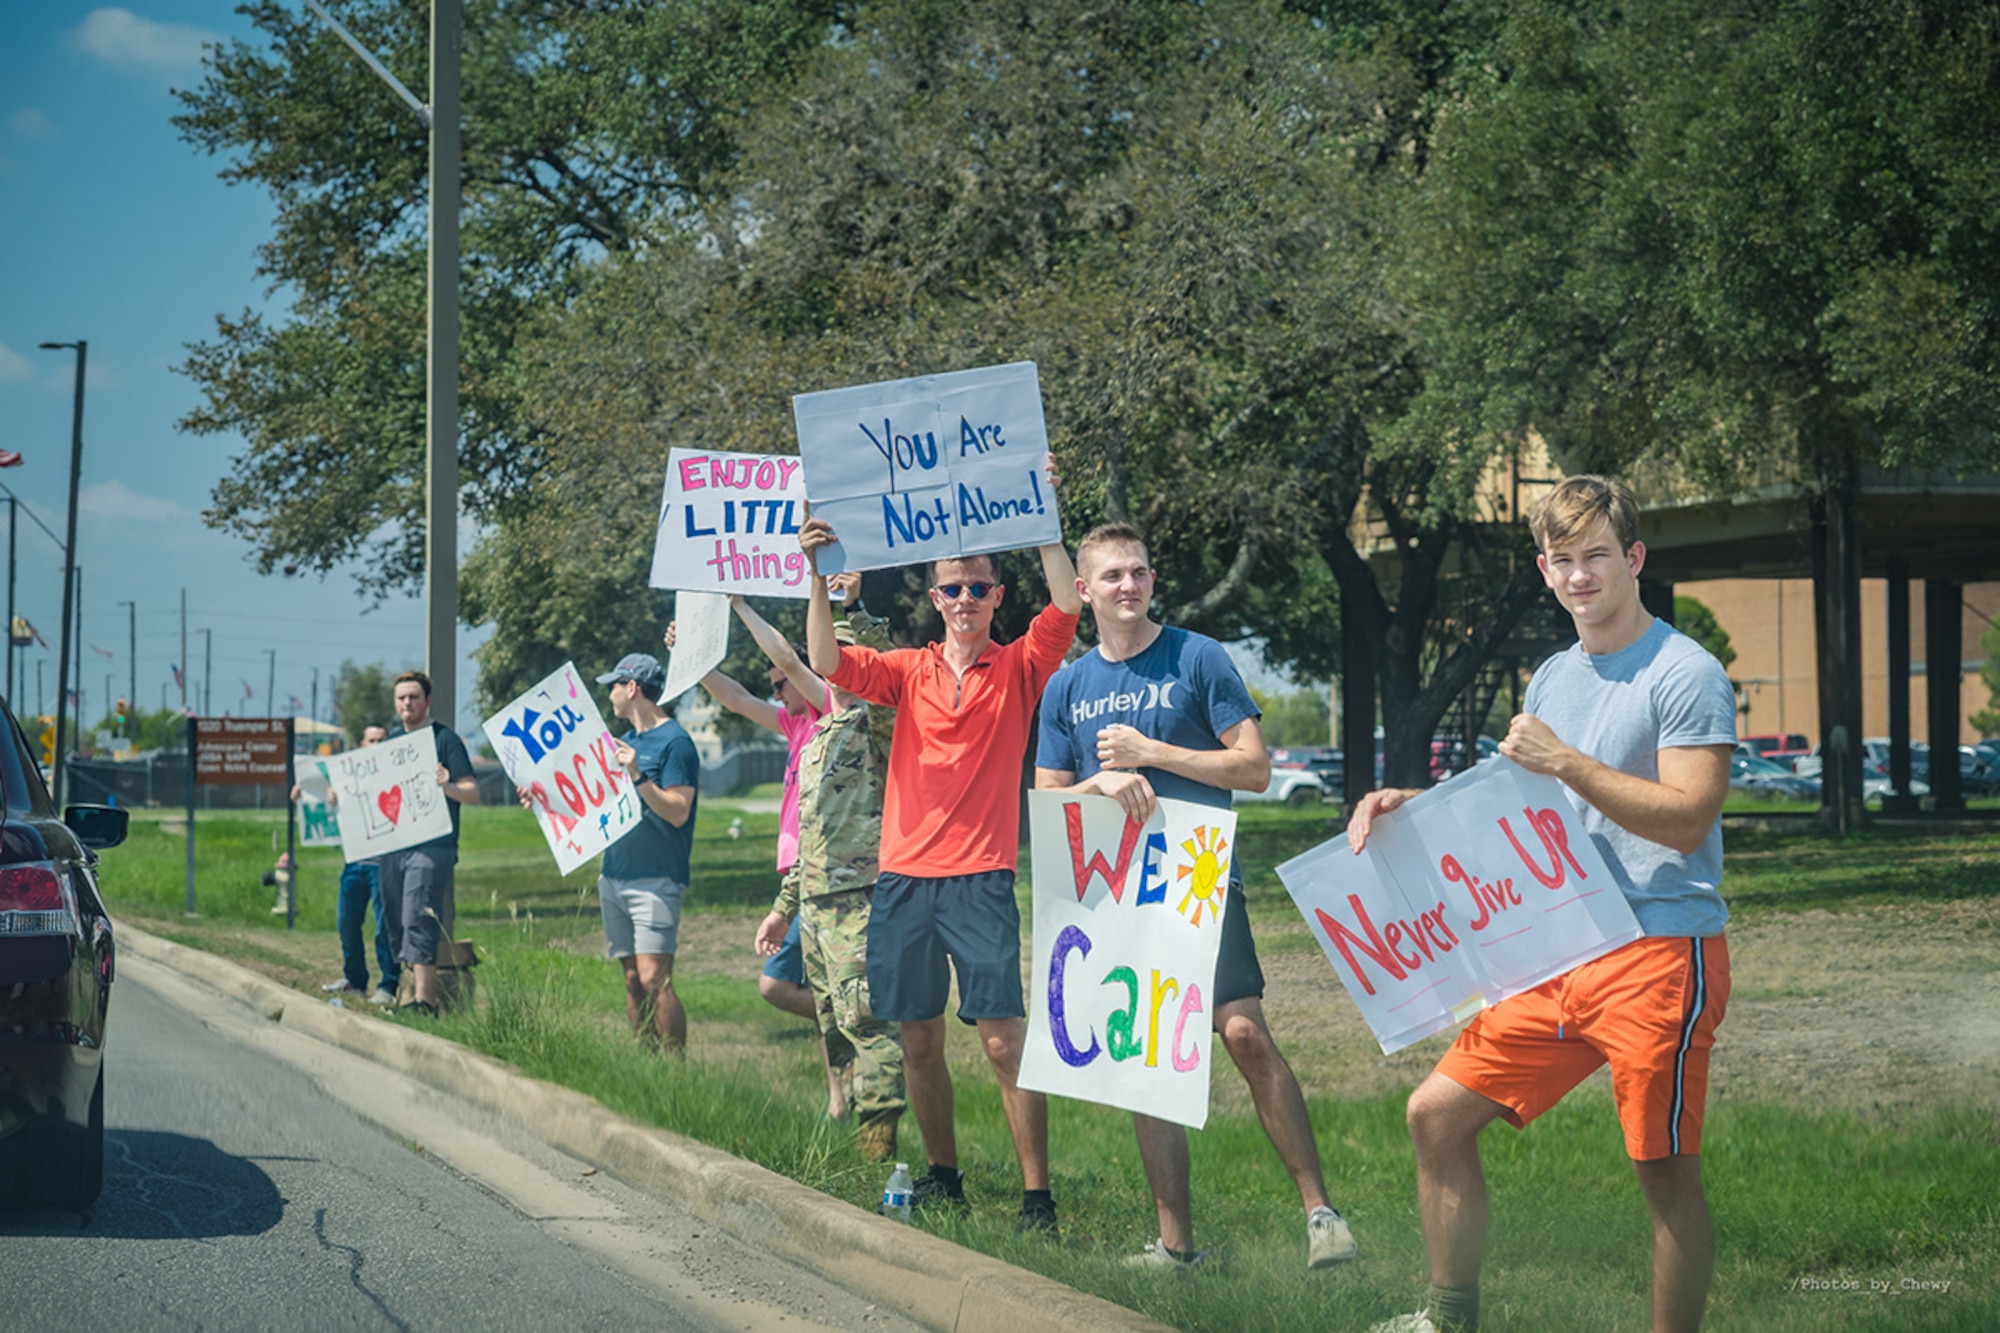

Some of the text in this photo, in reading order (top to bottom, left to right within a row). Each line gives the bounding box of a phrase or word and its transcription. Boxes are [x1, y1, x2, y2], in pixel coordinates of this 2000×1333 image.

[678, 454, 800, 492] ENJOY
[858, 414, 1007, 495] You Are
[683, 499, 802, 538] LITTL
[881, 470, 1046, 548] Not Alone!
[706, 538, 812, 586] thing
[501, 704, 585, 765] You
[1070, 688, 1146, 725] Hurley
[531, 738, 624, 842] ROCK
[1063, 801, 1168, 906] WE
[1314, 806, 1588, 996] Never give UP
[1048, 925, 1204, 1073] Care
